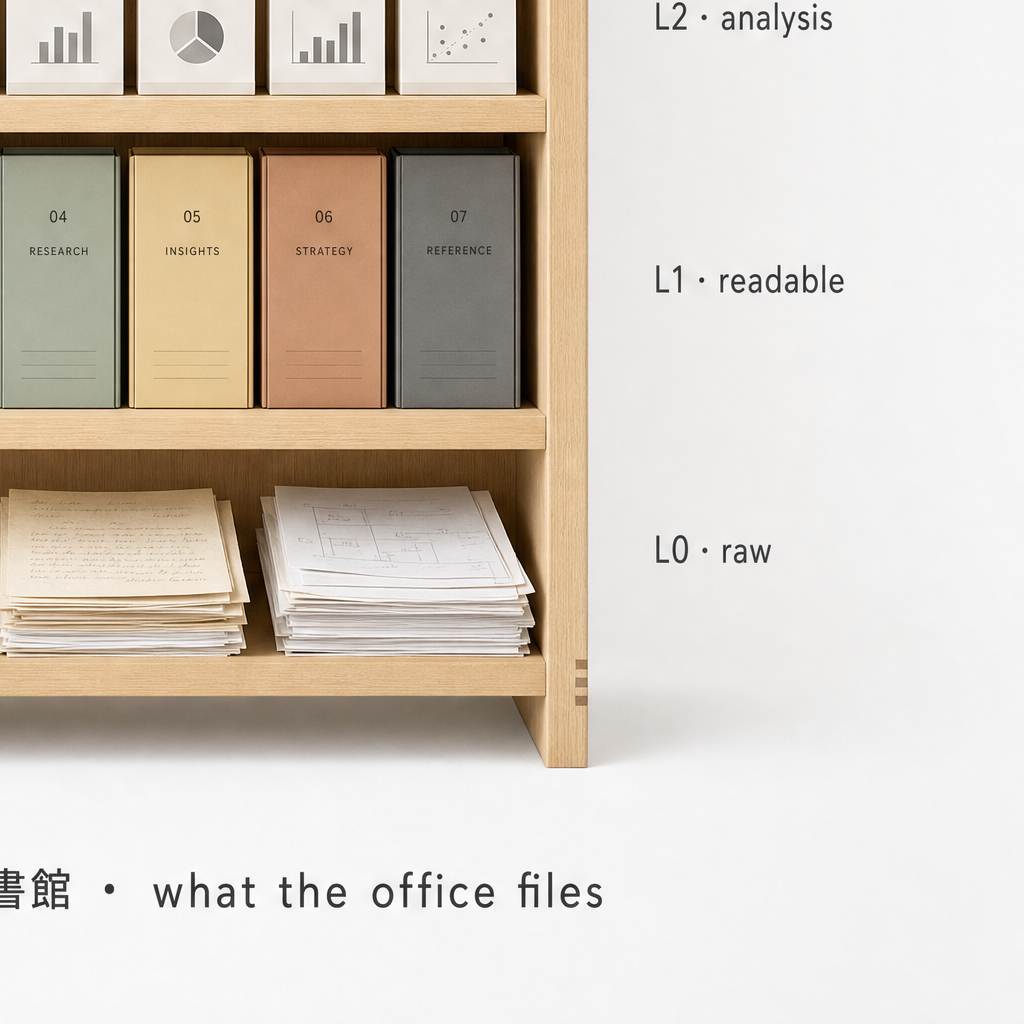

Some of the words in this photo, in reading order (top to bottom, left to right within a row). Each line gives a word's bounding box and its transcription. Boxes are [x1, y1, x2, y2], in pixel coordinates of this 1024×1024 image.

[49, 209, 68, 224] 04
[183, 209, 201, 224] 05
[315, 209, 333, 224] 06
[450, 209, 467, 223] 07
[29, 246, 89, 256] RESEARCH
[165, 246, 220, 256] INSIGHTS
[295, 246, 353, 256] STRATEGY
[426, 245, 492, 256] REFERENCE
